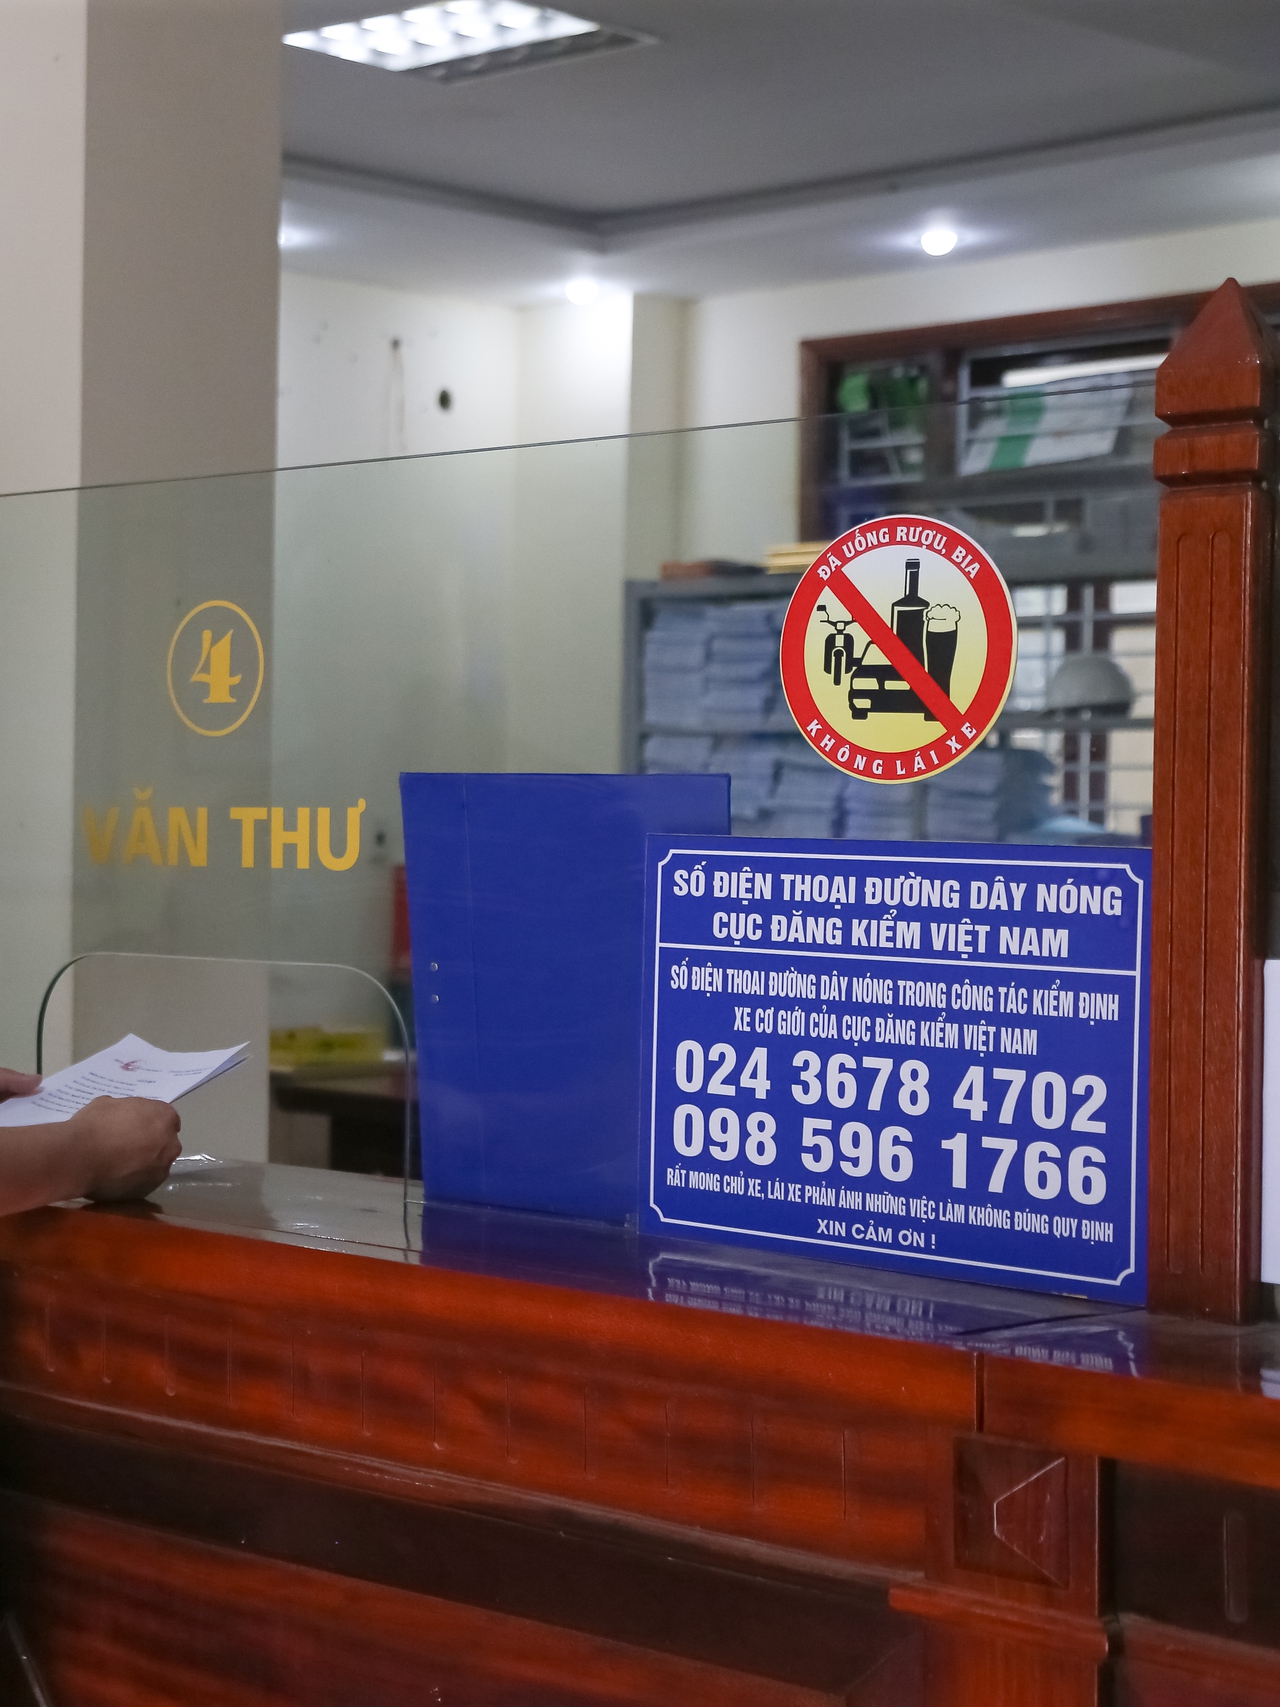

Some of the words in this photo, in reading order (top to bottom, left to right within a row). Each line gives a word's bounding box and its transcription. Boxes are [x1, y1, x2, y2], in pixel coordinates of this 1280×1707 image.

[817, 552, 842, 581] ĐÃ
[842, 527, 890, 558] UỐNG
[896, 526, 947, 554] RƯỢU,
[951, 546, 981, 579] BIA
[190, 630, 242, 703] 4
[806, 719, 883, 774] KHÔNG
[896, 752, 940, 775] LÁI
[946, 722, 977, 754] XE
[82, 787, 208, 867] VĂN
[230, 798, 366, 871] THƯ
[673, 861, 707, 896] SỐ
[713, 867, 772, 905] ĐIỆN
[781, 873, 856, 909] THOẠI
[864, 872, 960, 908] ĐƯỜNG
[970, 876, 1027, 911] DÂY
[1036, 879, 1122, 915] NÓNG
[713, 912, 762, 945] CỤC
[771, 910, 843, 945] ĐĂNG
[852, 909, 921, 949] KIỂM
[930, 918, 990, 958] VIỆT
[999, 926, 1069, 958] NAM
[671, 957, 688, 989] SỐ
[692, 962, 722, 996] ĐIỆN
[769, 967, 816, 999] ĐƯỜNG
[821, 971, 848, 1001] DÂY
[852, 973, 893, 1005] NÓNG
[898, 980, 946, 1008] TRONG
[952, 979, 993, 1012] CÔNG
[999, 982, 1027, 1014] TÁC
[1033, 980, 1073, 1017] KIỂM
[1079, 992, 1119, 1025] ĐỊNH
[734, 1006, 751, 1031] XE
[755, 1007, 774, 1033] CƠ
[778, 1006, 805, 1036] GIỚI
[809, 1005, 838, 1038] CỦA
[842, 1014, 870, 1046] CỤC
[875, 1013, 915, 1045] ĐĂNG
[921, 1012, 958, 1048] KIỂM
[964, 1020, 996, 1057] VIỆT
[1001, 1027, 1038, 1055] NAM
[675, 1040, 770, 1099] 024
[791, 1050, 930, 1117] 3678
[953, 1065, 1107, 1135] 4702
[673, 1104, 777, 1166] 098
[800, 1117, 914, 1182] 596
[941, 1132, 1107, 1205] 1766
[667, 1163, 687, 1187] RẤT
[689, 1171, 720, 1192] MONG
[723, 1171, 745, 1196] CHỦ
[748, 1178, 764, 1199] XE,
[768, 1180, 784, 1200] LÁI
[788, 1183, 802, 1202] XE
[805, 1181, 835, 1207] PHẢN
[839, 1186, 862, 1210] ÁNH
[866, 1191, 906, 1216] NHỮNG
[909, 1196, 936, 1223] VIỆC
[939, 1199, 965, 1224] LÀM
[969, 1204, 1010, 1230] KHÔNG
[1014, 1209, 1048, 1234] ĐÚNG
[1053, 1216, 1077, 1238] QUY
[1082, 1220, 1113, 1245] ĐỊNH
[817, 1218, 846, 1237] XIN
[852, 1220, 892, 1243] CẢM
[898, 1228, 925, 1248] ƠN
[931, 1234, 936, 1249] !
